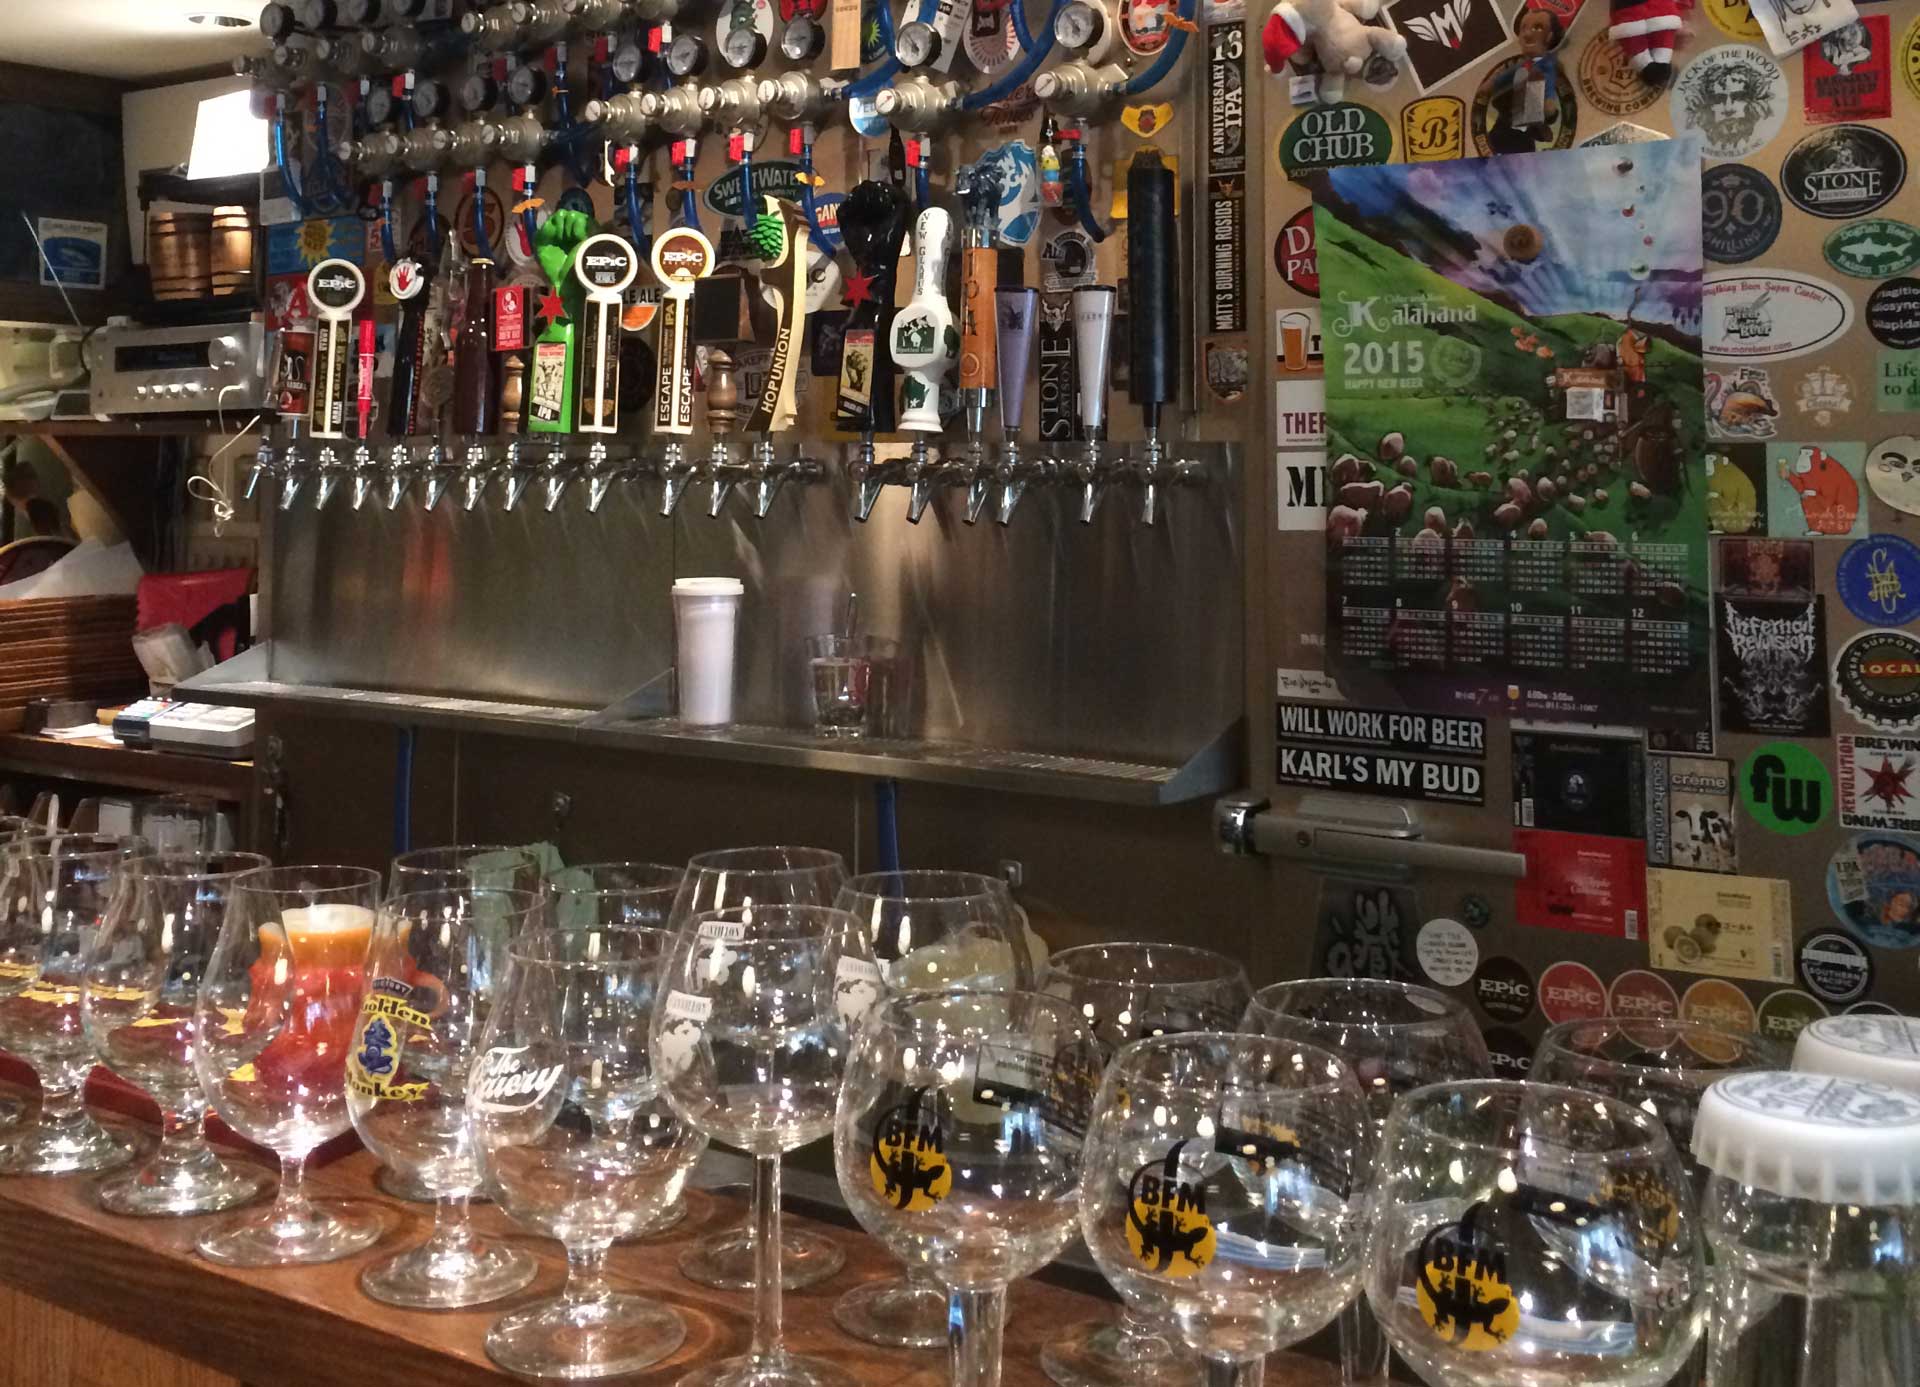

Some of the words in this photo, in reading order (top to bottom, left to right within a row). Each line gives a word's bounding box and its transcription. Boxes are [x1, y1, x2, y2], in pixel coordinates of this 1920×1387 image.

[1678, 64, 1704, 95] JACK
[1701, 52, 1717, 70] OF
[1721, 49, 1742, 60] THE
[1745, 49, 1782, 82] WOOD
[1213, 64, 1225, 154] ANNIVERSARY
[1224, 86, 1243, 128] IPA
[1301, 107, 1367, 136] OLD
[1293, 133, 1375, 162] CHUB
[1803, 171, 1883, 201] STONE
[1214, 200, 1233, 240] ROSIDS
[1284, 226, 1315, 256] D
[1215, 243, 1233, 290] BURNING
[1286, 258, 1318, 282] PA
[664, 303, 675, 326] IPA
[1215, 293, 1234, 330] MATT'S
[760, 327, 791, 414] HOPUNION
[1343, 340, 1425, 376] 2015
[660, 366, 672, 422] ESCAPE
[680, 367, 692, 423] ESCAPE
[1041, 337, 1071, 439] STONE
[1861, 637, 1920, 655] SUPPORT
[1860, 663, 1920, 674] LOCAL
[1280, 705, 1323, 734] WILL
[1327, 709, 1385, 739] WORK
[1389, 714, 1427, 743] FOR
[1432, 718, 1484, 749] BEER
[1281, 748, 1369, 783] KARL'S
[1375, 758, 1416, 787] MY
[1422, 762, 1480, 794] BUD
[1839, 735, 1855, 813] REVOLUTION
[484, 1046, 531, 1077] The
[885, 1120, 943, 1155] BFM
[1140, 1174, 1206, 1215] BFM
[1432, 1237, 1507, 1285] BFM
